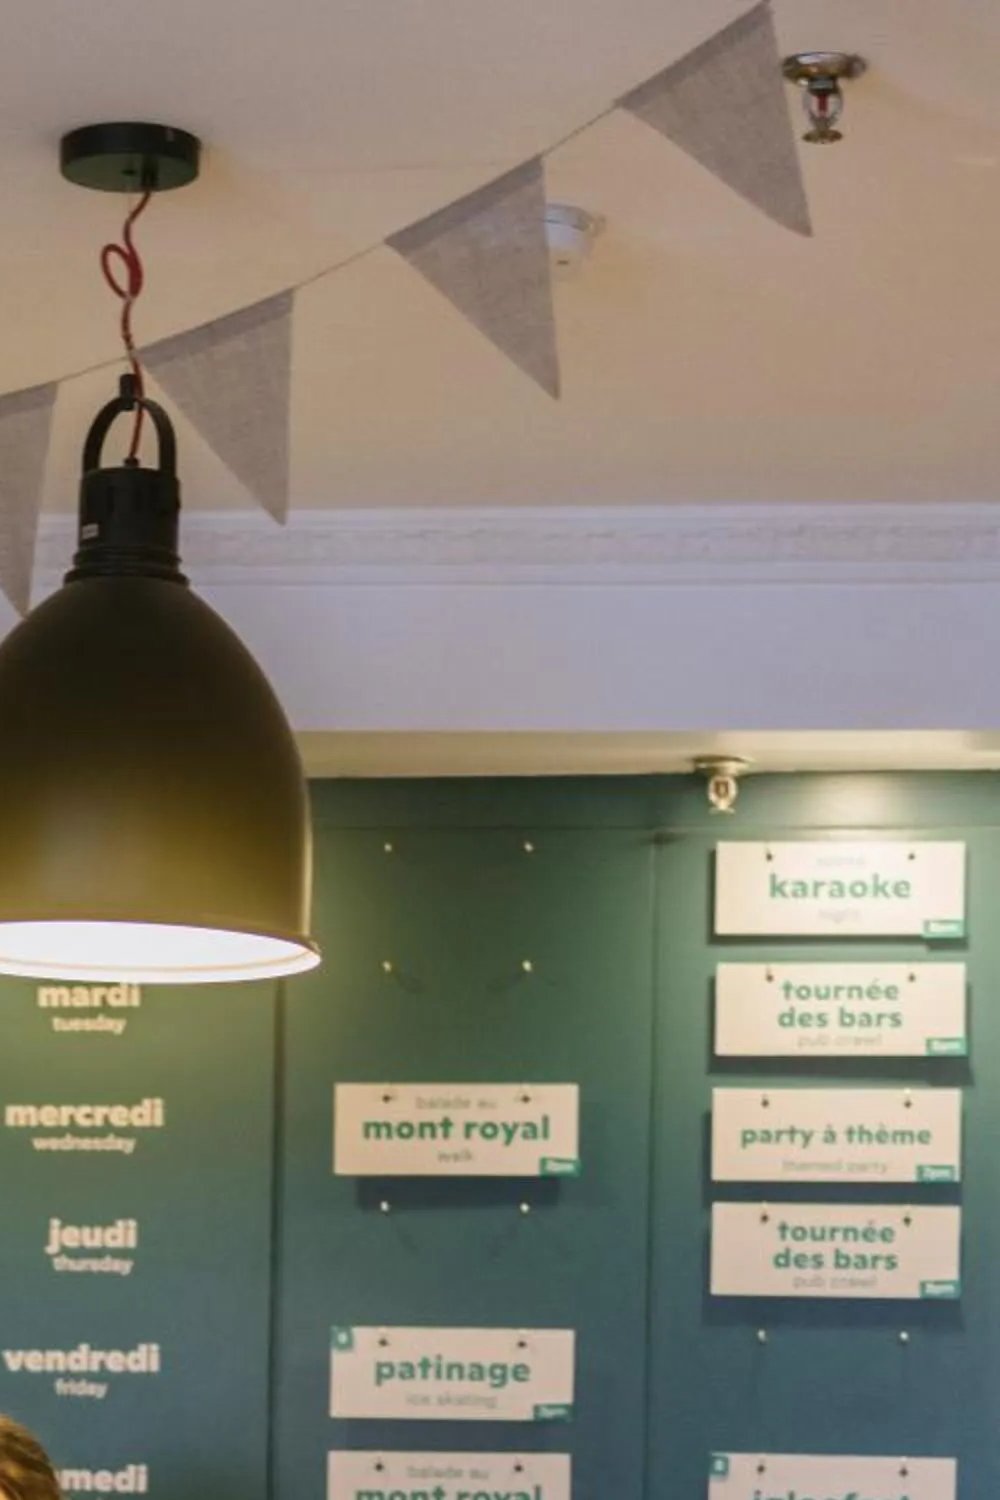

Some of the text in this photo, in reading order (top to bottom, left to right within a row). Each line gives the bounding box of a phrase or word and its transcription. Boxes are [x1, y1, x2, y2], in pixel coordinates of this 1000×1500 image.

[769, 873, 911, 899] karaoke
[37, 983, 141, 1007] mardi
[782, 979, 900, 1001] tournée
[52, 1014, 127, 1035] tuesday
[777, 1007, 903, 1028] des bars
[5, 1098, 165, 1127] mercredi
[362, 1115, 551, 1146] mont royal
[740, 1124, 932, 1149] party à thème
[45, 1218, 137, 1254] jeudi
[778, 1220, 896, 1243] tournée
[52, 1255, 134, 1276] thursday
[773, 1249, 898, 1270] des bars
[2, 1343, 161, 1372] vendredi
[375, 1354, 531, 1389] patinage
[55, 1378, 107, 1399] friday
[57, 1464, 148, 1493] medi
